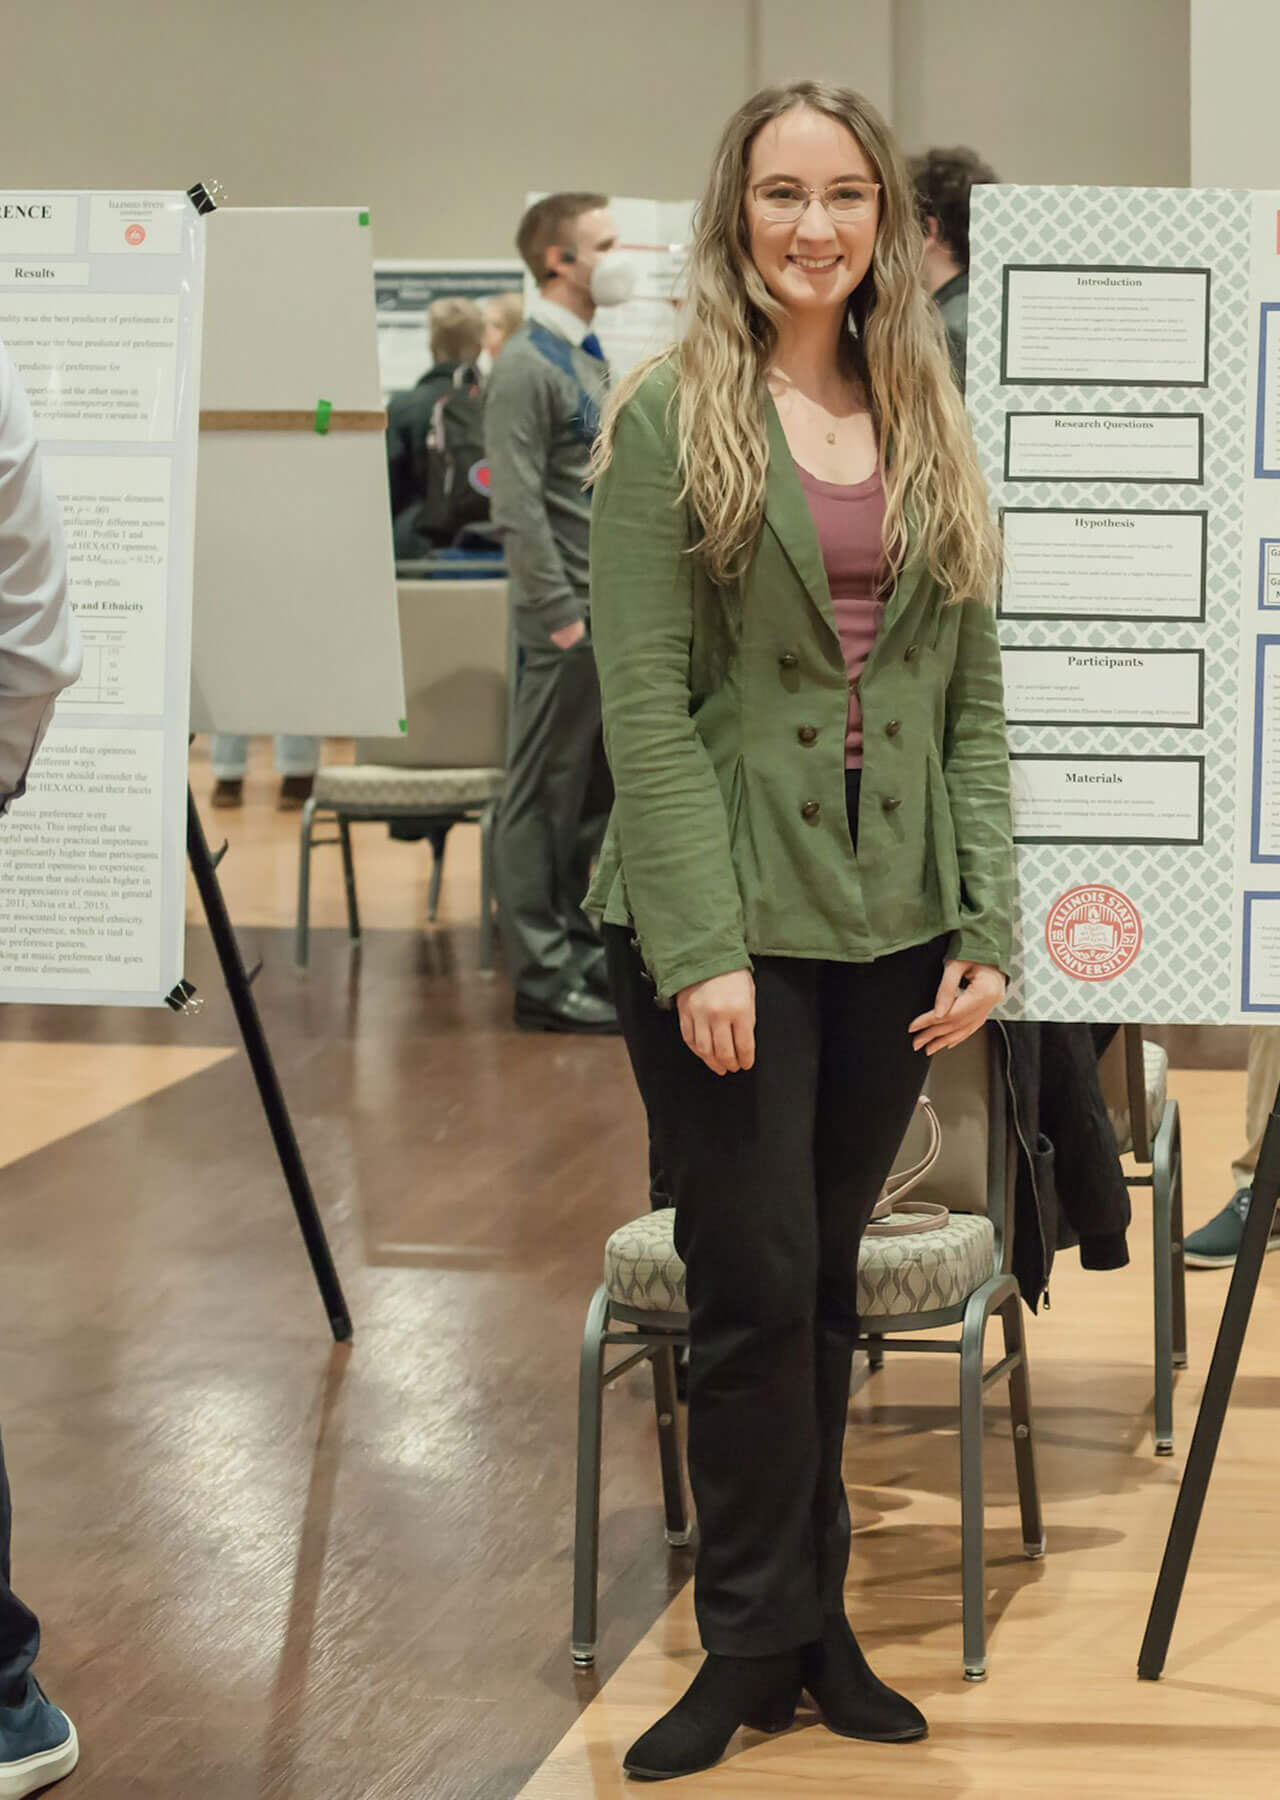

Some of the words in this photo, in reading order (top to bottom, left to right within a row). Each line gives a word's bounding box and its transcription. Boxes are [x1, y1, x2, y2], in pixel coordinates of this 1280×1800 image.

[0, 205, 52, 219] ENCE
[14, 267, 56, 279] Results
[1077, 277, 1143, 287] Introduction
[1054, 419, 1101, 429] Research
[1103, 420, 1154, 430] Questions
[1074, 517, 1135, 529] Hypothesis
[80, 602, 99, 611] and
[101, 602, 144, 613] Ethnicity
[1067, 655, 1144, 669] Participants
[1065, 773, 1124, 784] Materials
[1053, 892, 1106, 928] ILLINOIS
[1107, 896, 1135, 930] STATE
[1056, 944, 1129, 975] UNIVERSITY
